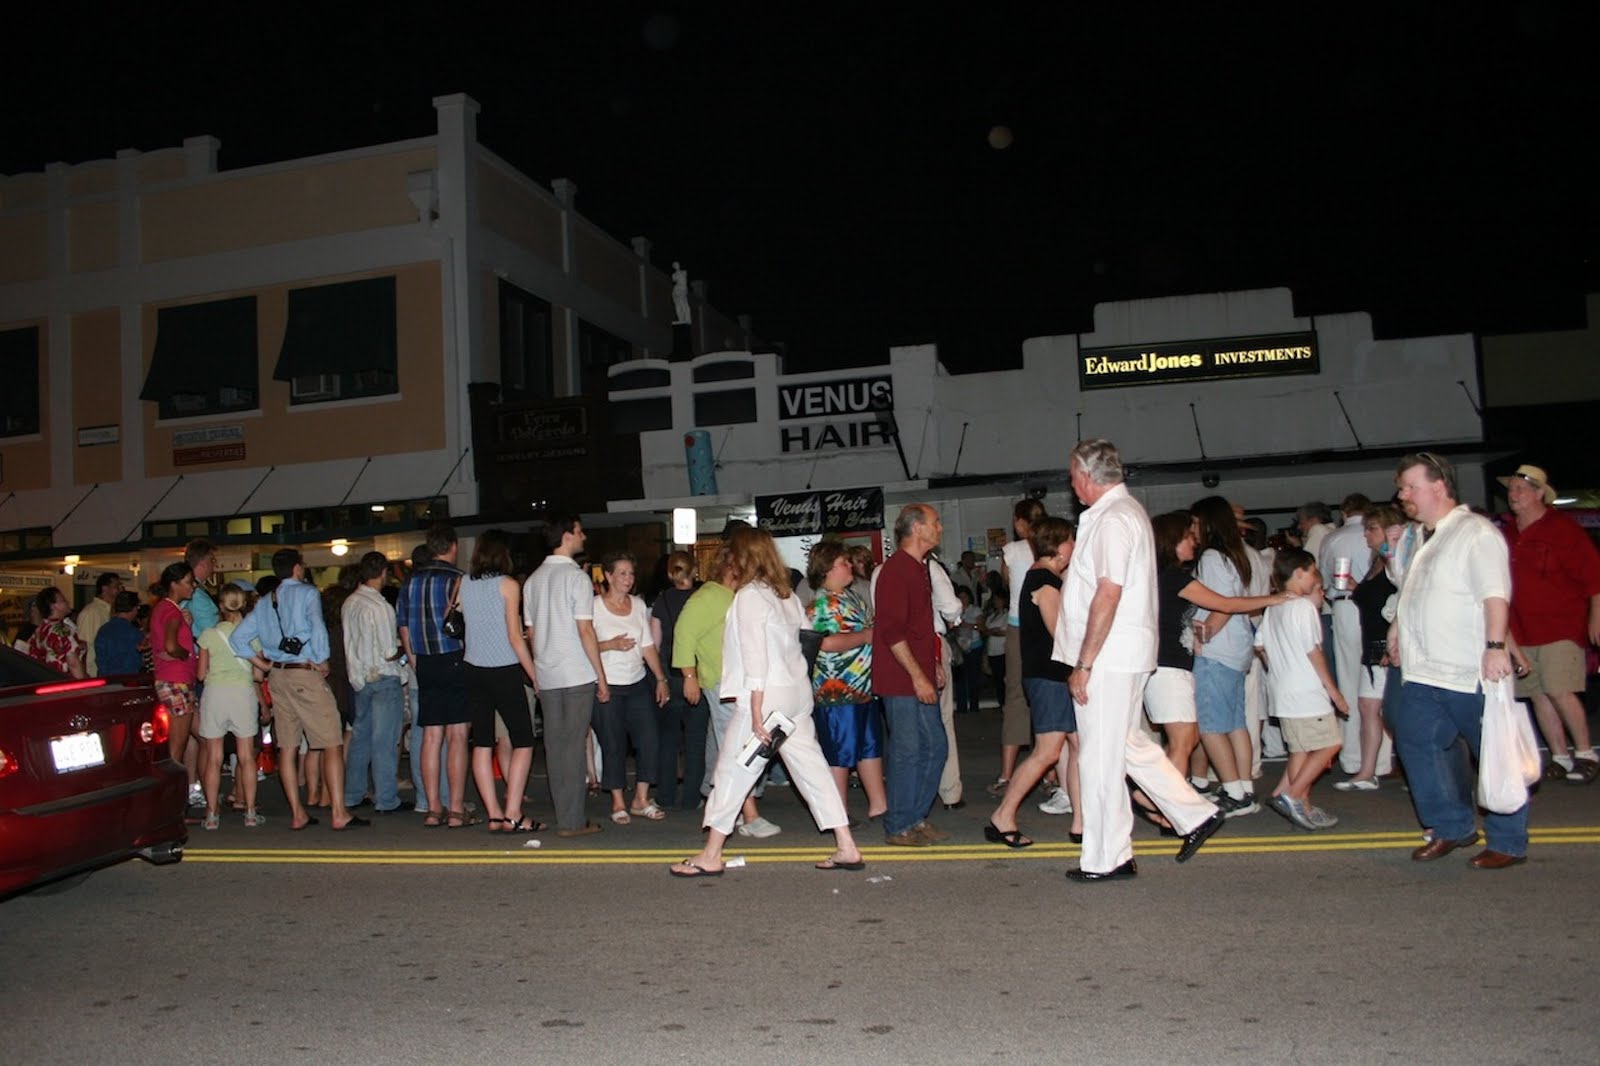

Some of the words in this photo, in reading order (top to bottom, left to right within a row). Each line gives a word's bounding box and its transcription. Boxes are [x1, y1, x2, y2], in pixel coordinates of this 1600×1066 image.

[1214, 346, 1312, 366] INVESTMENTS
[781, 381, 892, 416] VENUS
[781, 421, 891, 452] HAIR
[770, 497, 820, 516] Venus
[824, 493, 869, 512] Hair
